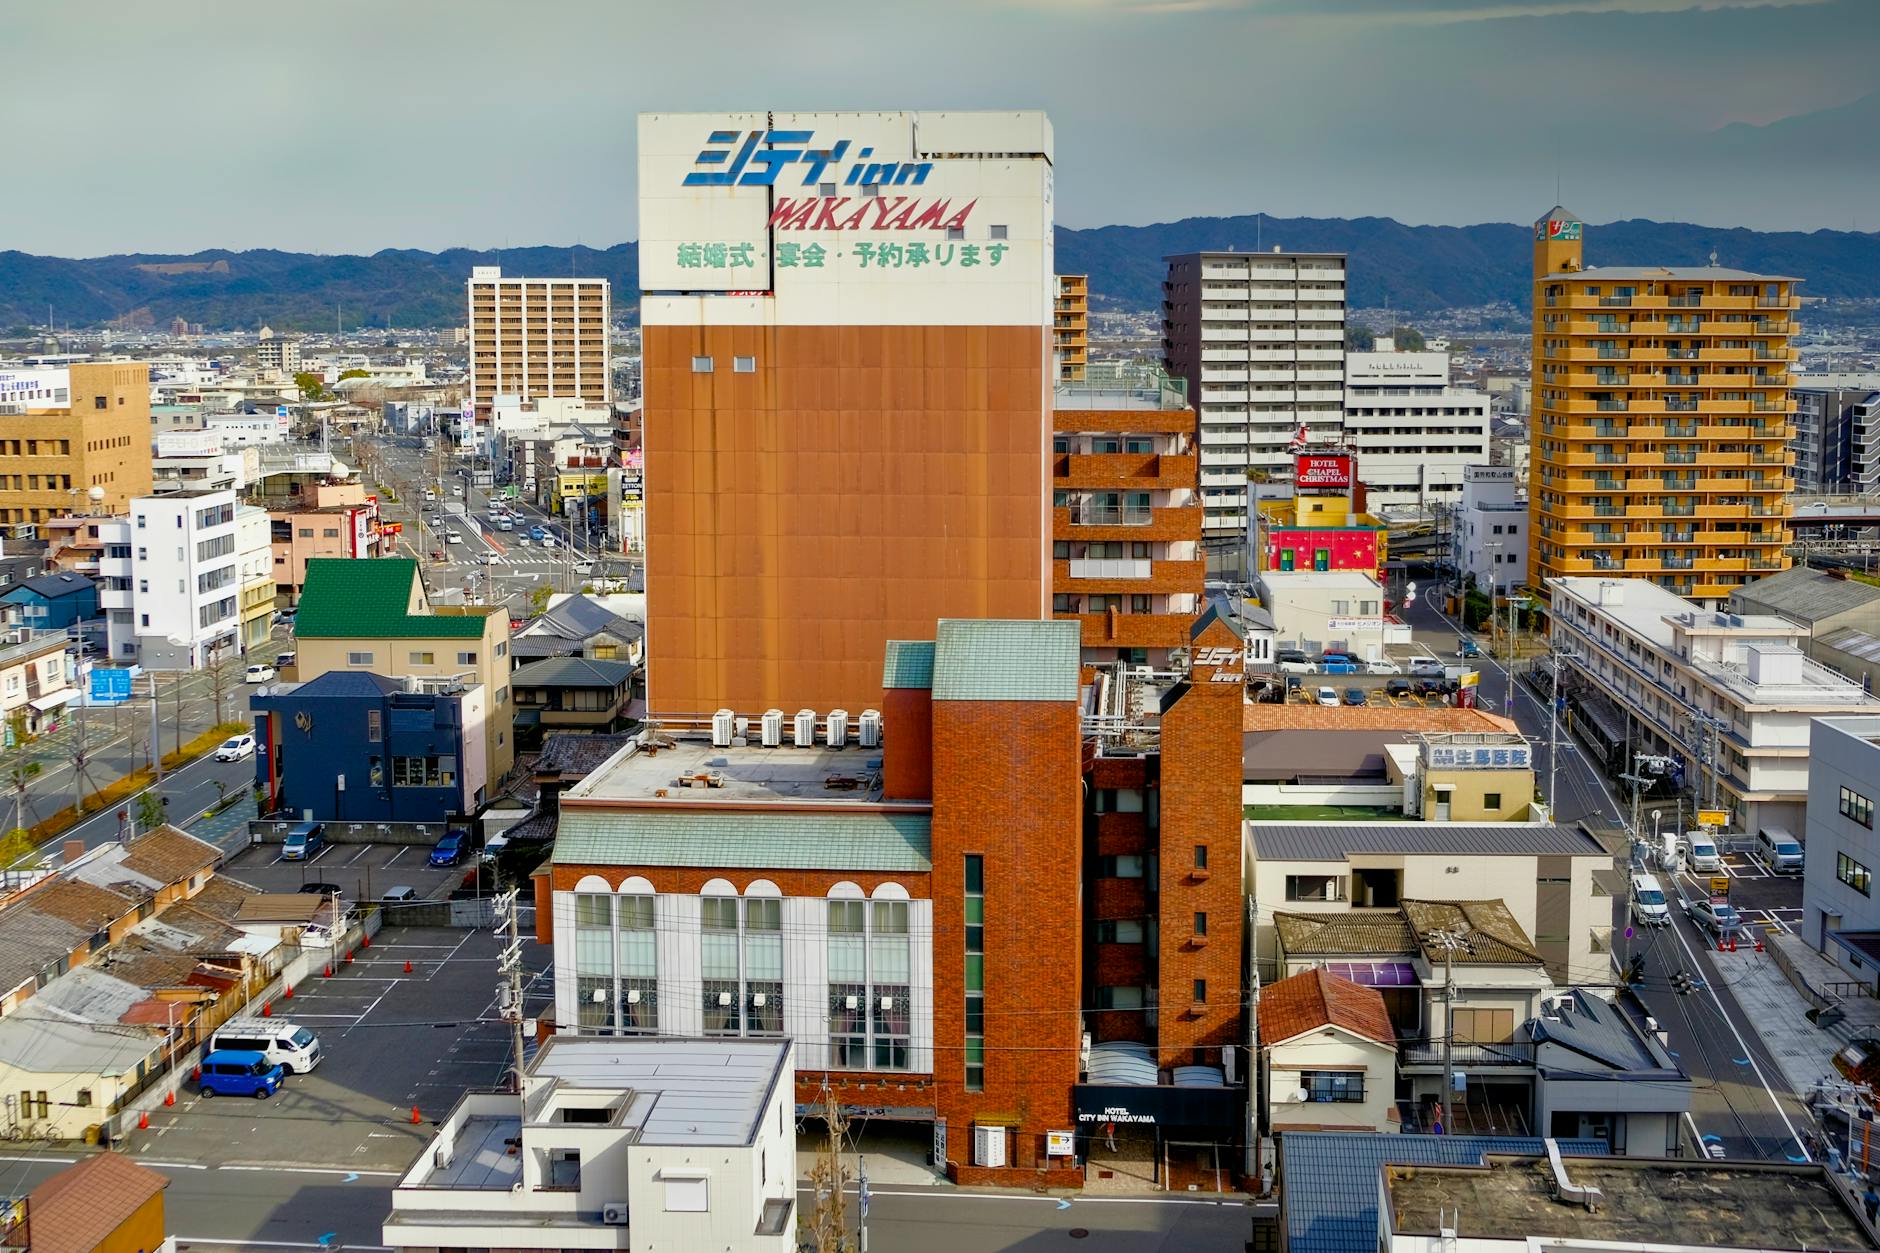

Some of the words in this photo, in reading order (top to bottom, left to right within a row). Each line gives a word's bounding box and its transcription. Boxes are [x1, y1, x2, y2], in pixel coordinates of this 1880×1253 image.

[844, 147, 934, 186] inn
[765, 197, 979, 231] WAKAYAMA
[1299, 475, 1349, 483] CHRISTMAS
[1210, 667, 1244, 682] inn
[1104, 1107, 1130, 1115] HOTEL
[1078, 1114, 1096, 1122] CITY
[1097, 1114, 1109, 1122] INN
[1110, 1115, 1155, 1123] WAKAYAMA
